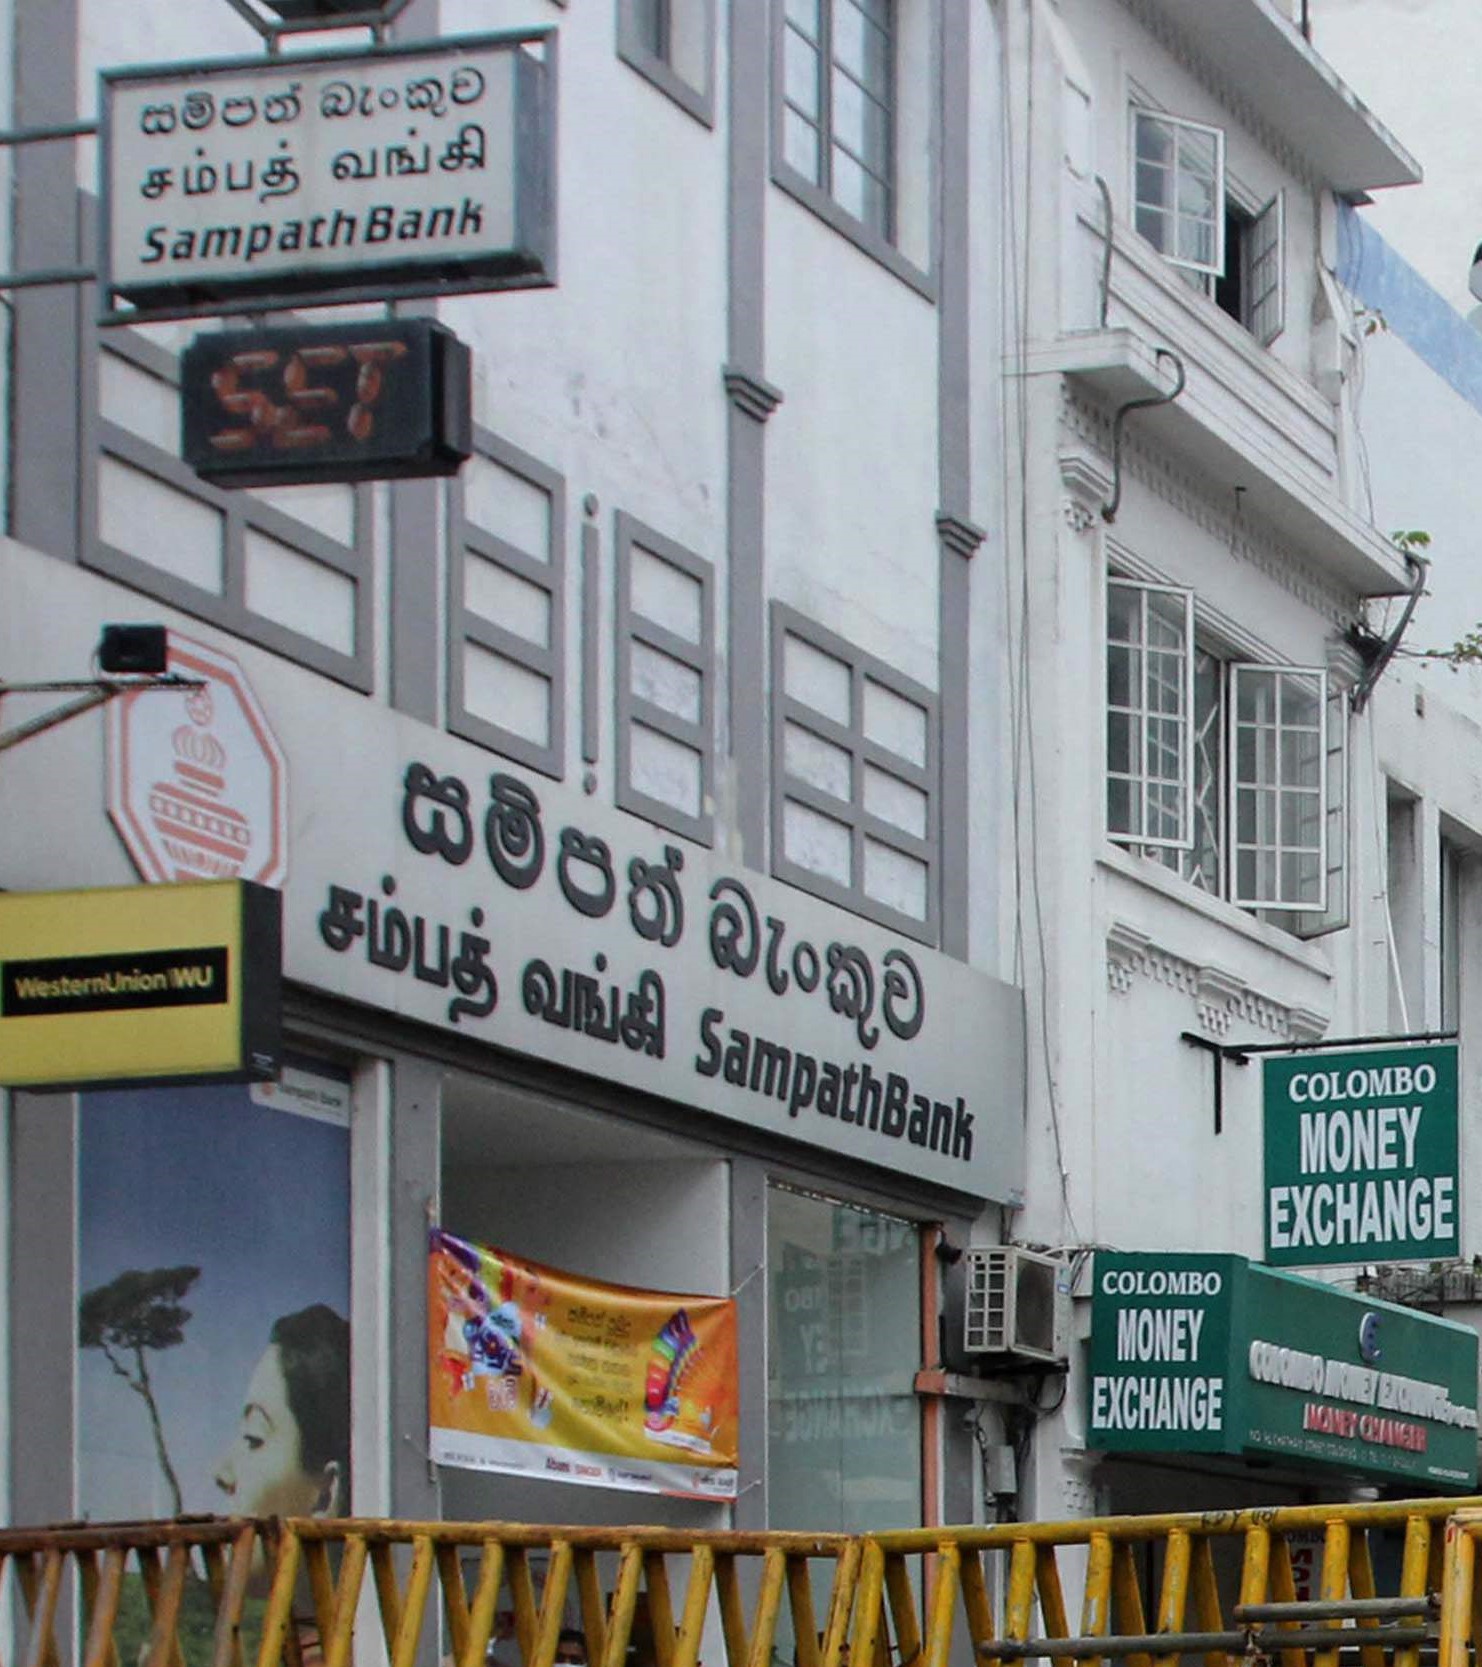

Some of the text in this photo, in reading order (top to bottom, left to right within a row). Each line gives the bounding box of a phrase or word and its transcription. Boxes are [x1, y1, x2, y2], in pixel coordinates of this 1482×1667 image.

[141, 125, 486, 202] சம்பத் வங்கி
[403, 762, 924, 1050] සම්පත් බැංකුව
[319, 875, 666, 1060] சம்பத் வங்கி
[1289, 1064, 1436, 1104] COLOMBO
[1300, 1107, 1422, 1175] MONEY
[1270, 1177, 1454, 1248] EXCHANGE
[1102, 1271, 1222, 1296] COLOMBO
[1117, 1309, 1203, 1363] MONEY
[1092, 1377, 1222, 1431] EXCHANGE
